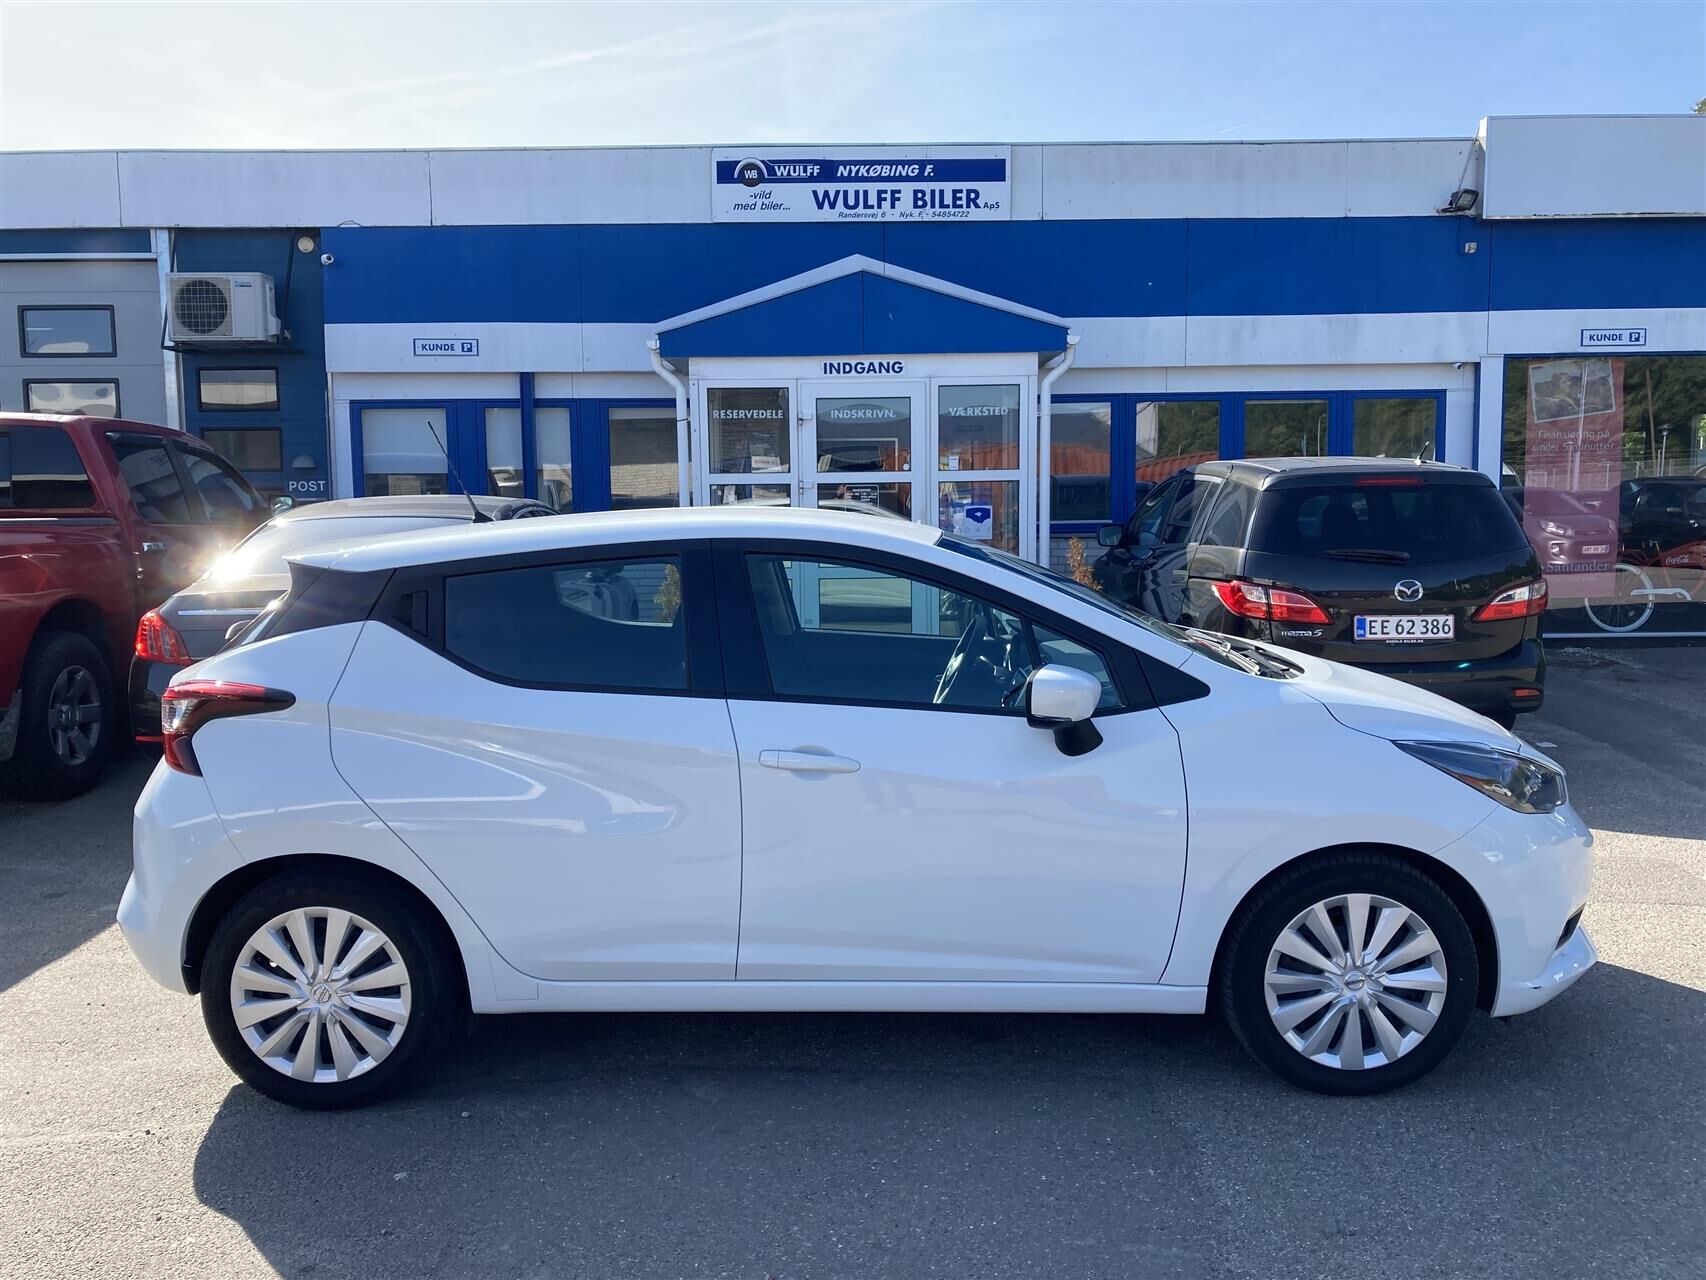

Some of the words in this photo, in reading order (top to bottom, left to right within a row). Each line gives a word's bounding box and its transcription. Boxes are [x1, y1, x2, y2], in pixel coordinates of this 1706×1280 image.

[744, 169, 758, 179] WB
[774, 165, 820, 177] WULFF
[836, 164, 919, 177] NYKØBING
[923, 164, 935, 176] F.
[749, 190, 772, 200] -vild
[812, 189, 902, 210] WULFF
[912, 188, 981, 209] BILER
[983, 201, 1000, 210] ApS
[733, 202, 757, 211] med
[760, 201, 791, 211] biler...
[838, 211, 878, 219] Randersvej
[899, 211, 916, 219] Nyk.
[931, 210, 970, 218] 54854722
[1589, 333, 1624, 342] KUNDE
[421, 343, 456, 352] KUNDE
[823, 361, 904, 375] INDGANG
[713, 409, 784, 419] RESERVEDELE
[830, 409, 896, 419] INDSKRIVN.
[949, 406, 1009, 416] VÆRKSTED
[1532, 442, 1559, 453] under
[289, 480, 326, 491] POST
[1547, 560, 1610, 572] Santander
[1368, 619, 1390, 635] EE
[1395, 618, 1416, 635] 62
[1420, 618, 1452, 635] 386
